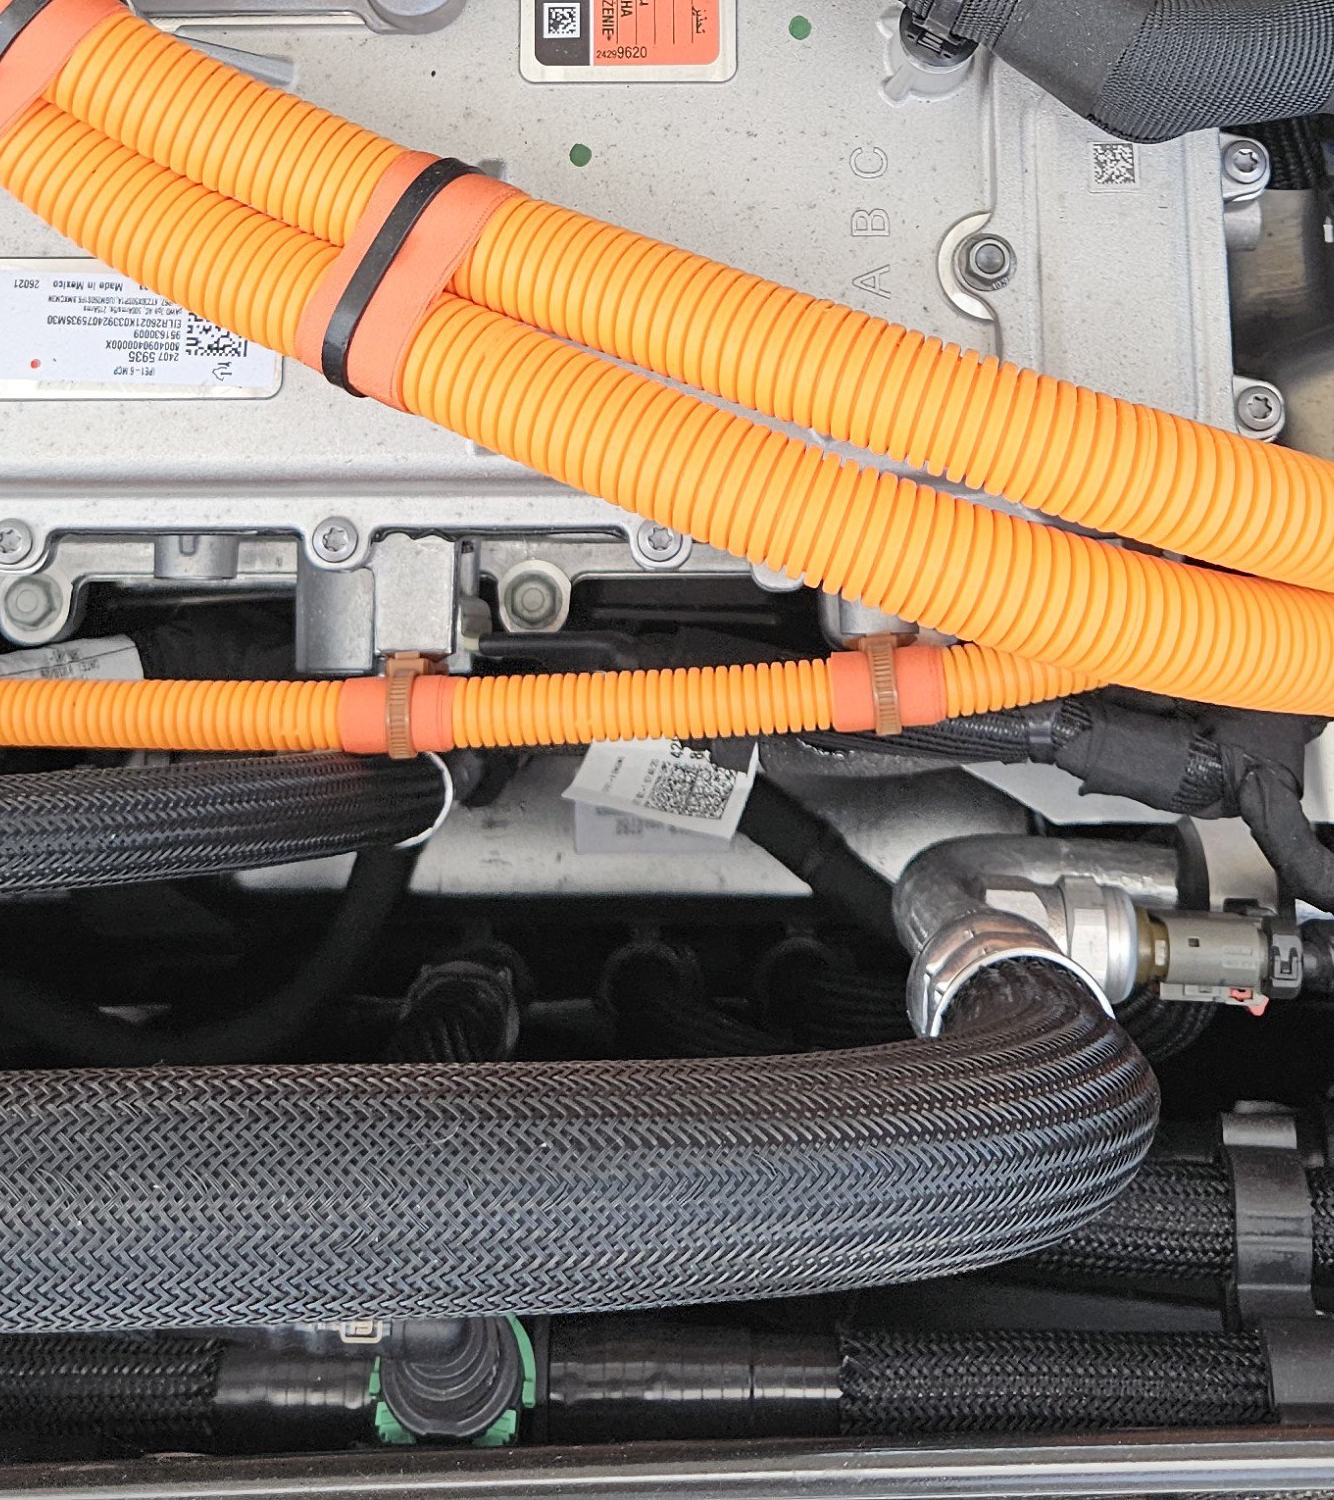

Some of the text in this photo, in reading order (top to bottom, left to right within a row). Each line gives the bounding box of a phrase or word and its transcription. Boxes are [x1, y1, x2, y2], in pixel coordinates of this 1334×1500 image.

[597, 47, 647, 59] 24299620
[849, 146, 891, 300] A B C
[14, 279, 123, 291] Made in Mexico 26021
[133, 330, 181, 340] 951630009
[128, 351, 179, 362] 2407 5935
